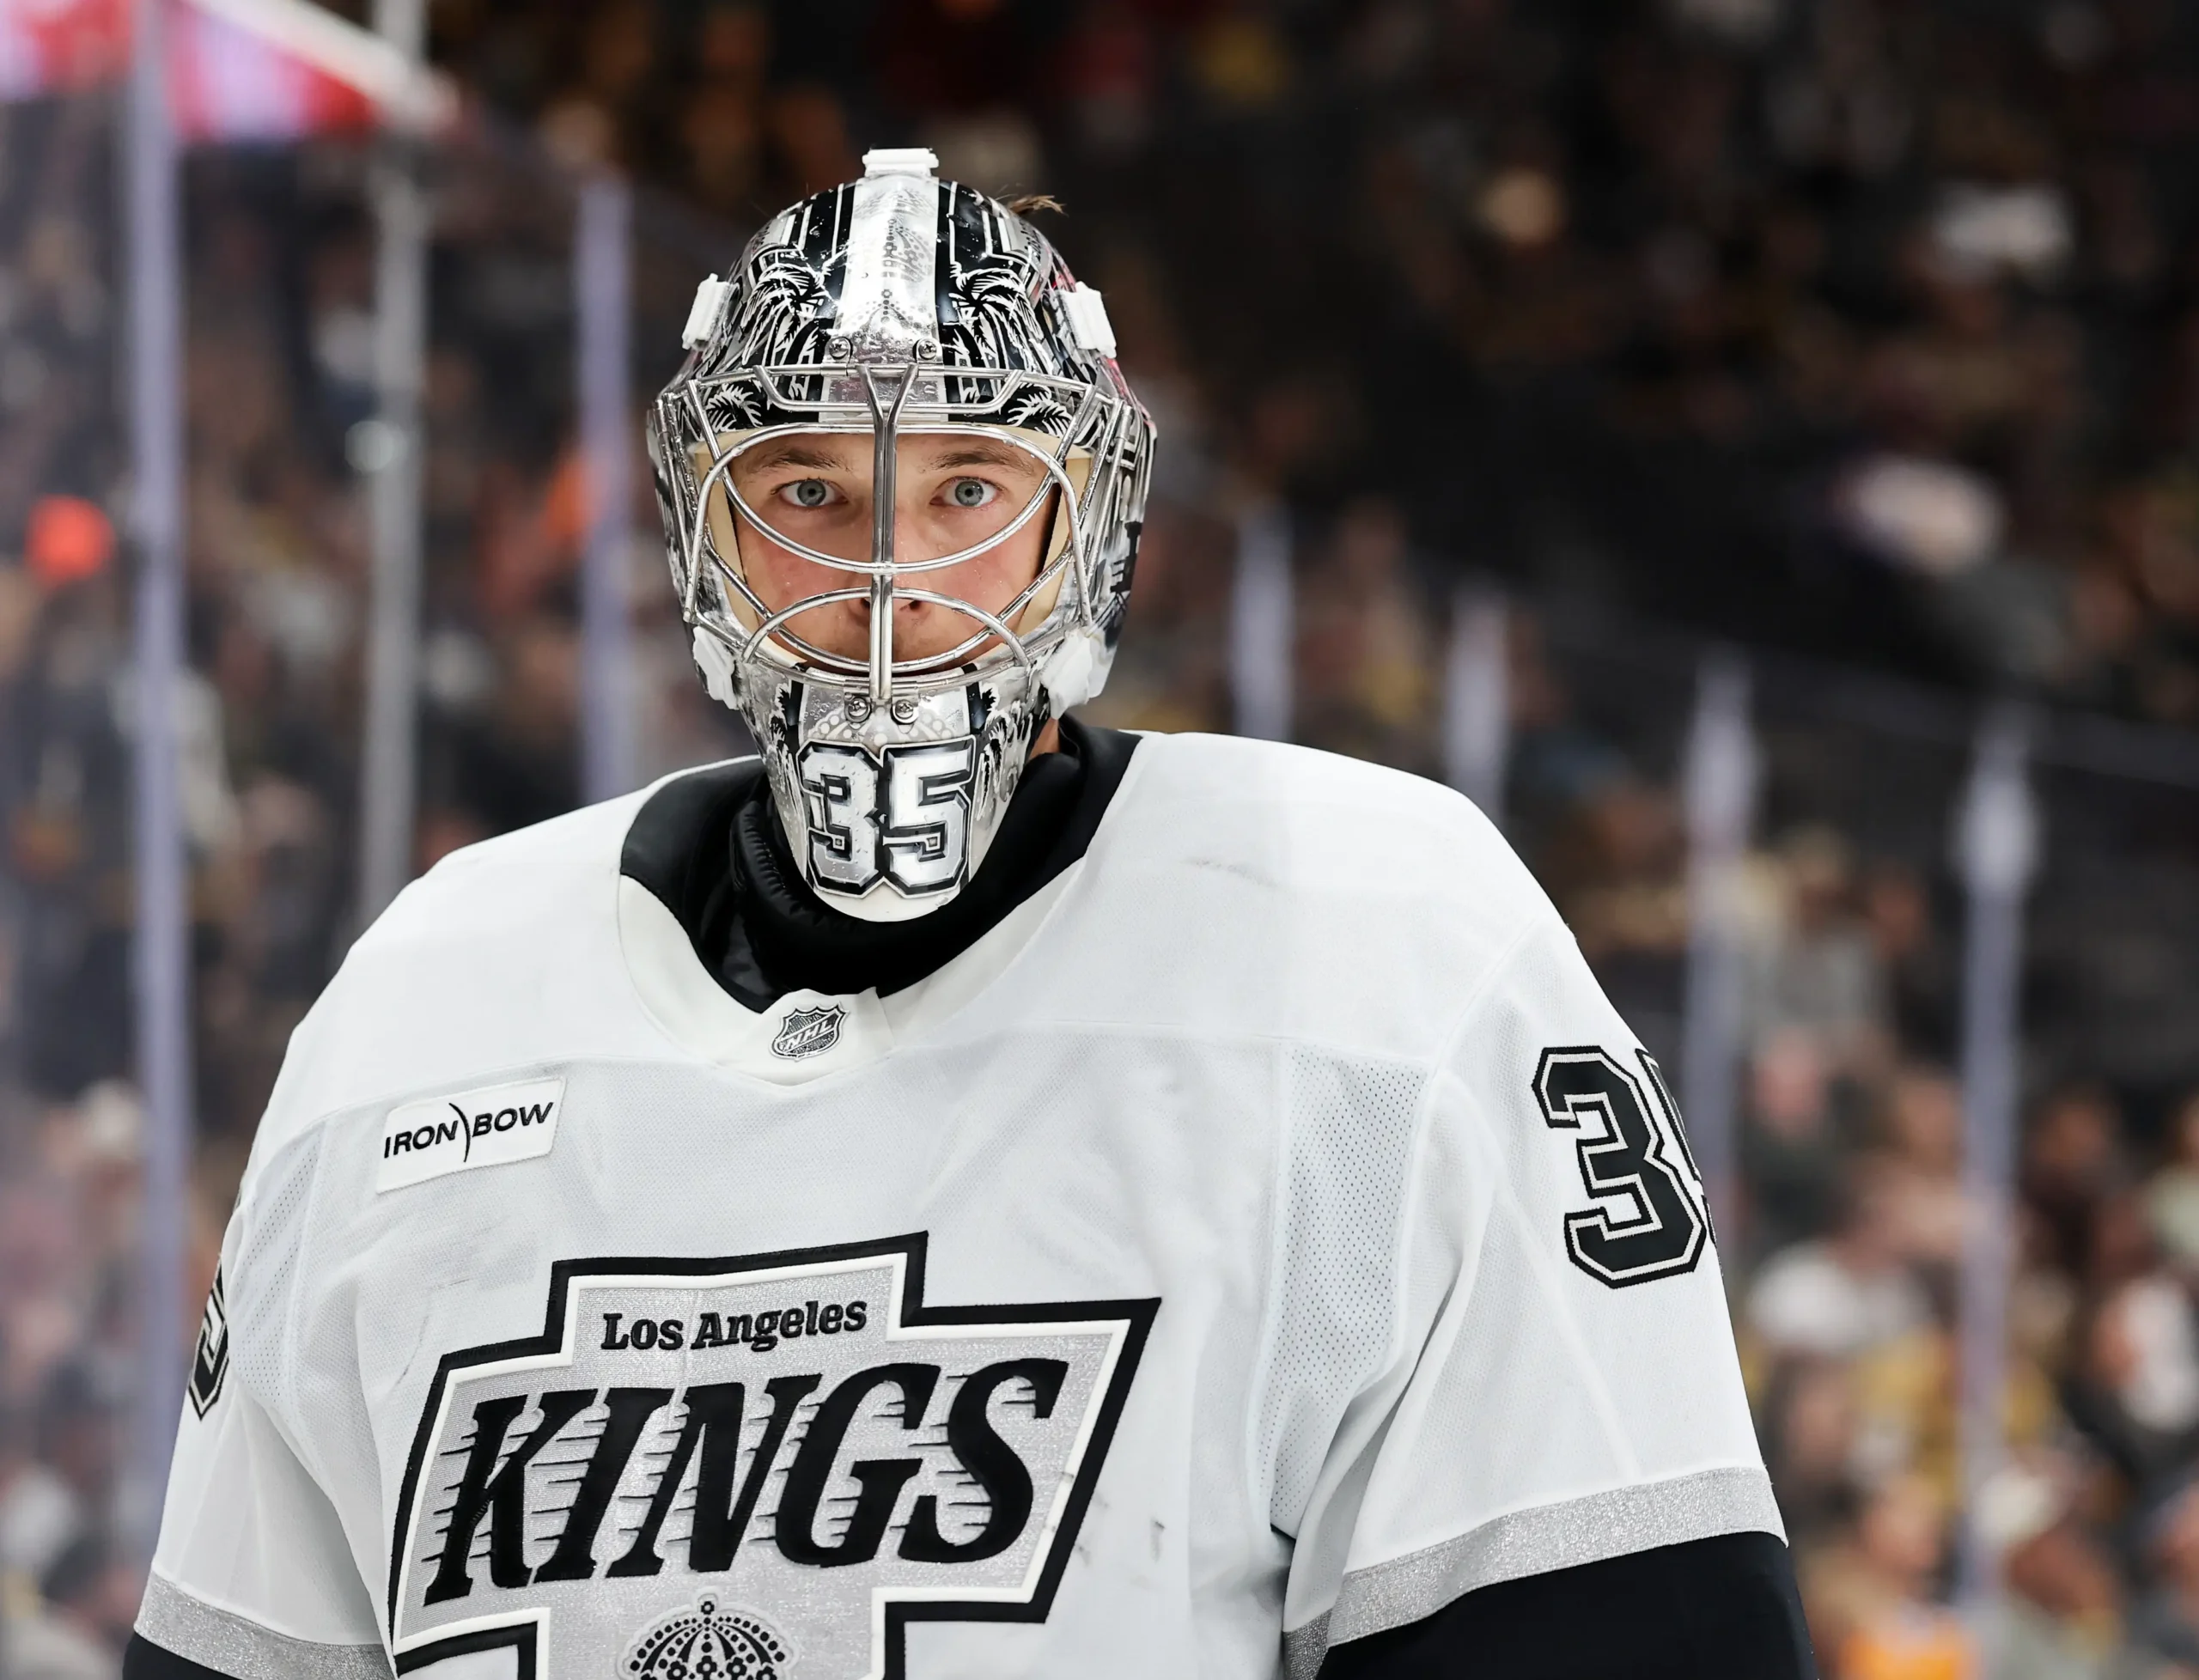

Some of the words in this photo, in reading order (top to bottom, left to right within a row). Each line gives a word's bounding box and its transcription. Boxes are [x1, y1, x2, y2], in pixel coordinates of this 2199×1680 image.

[798, 736, 975, 898] 35
[783, 1020, 832, 1050] NHL
[384, 1120, 459, 1159] IRON
[472, 1102, 554, 1138] BOW
[1531, 1045, 1717, 1289] 3
[600, 1312, 684, 1351] Los
[690, 1300, 868, 1353] Angeles
[423, 1357, 1069, 1606] KINGS
